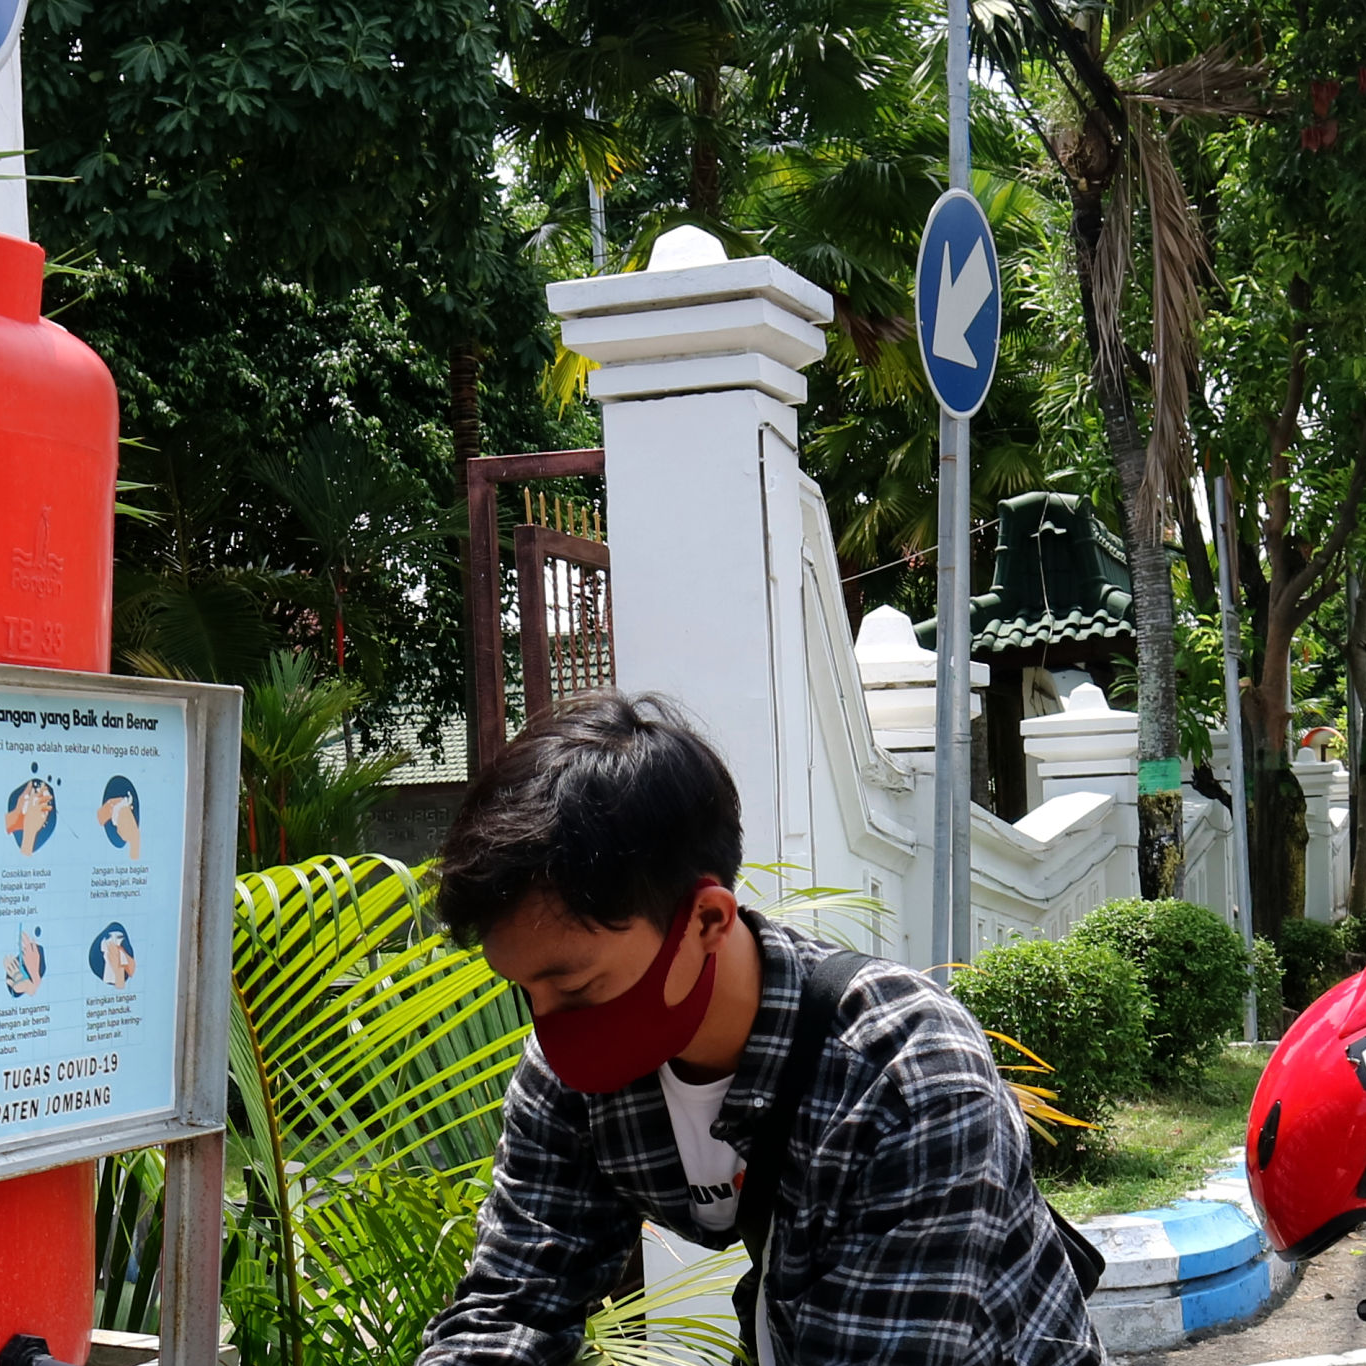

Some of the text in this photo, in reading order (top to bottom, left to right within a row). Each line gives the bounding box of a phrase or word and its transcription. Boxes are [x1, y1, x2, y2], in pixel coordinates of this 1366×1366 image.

[3, 615, 35, 652] TB
[39, 711, 70, 731] yang
[72, 708, 98, 727] Baik
[101, 710, 124, 729] dan
[126, 712, 159, 731] Benar
[36, 741, 63, 753] adalah
[64, 743, 90, 755] sekitar
[91, 743, 101, 755] 40
[102, 744, 128, 758] hingga
[129, 745, 140, 757] 60
[140, 746, 161, 758] detik.
[91, 866, 115, 877] Jangan
[24, 882, 47, 892] tangan
[115, 994, 137, 1004] tangan
[4, 1064, 51, 1091] TUGAS
[57, 1052, 119, 1081] COVID-19
[45, 1085, 111, 1116] JOMBANG
